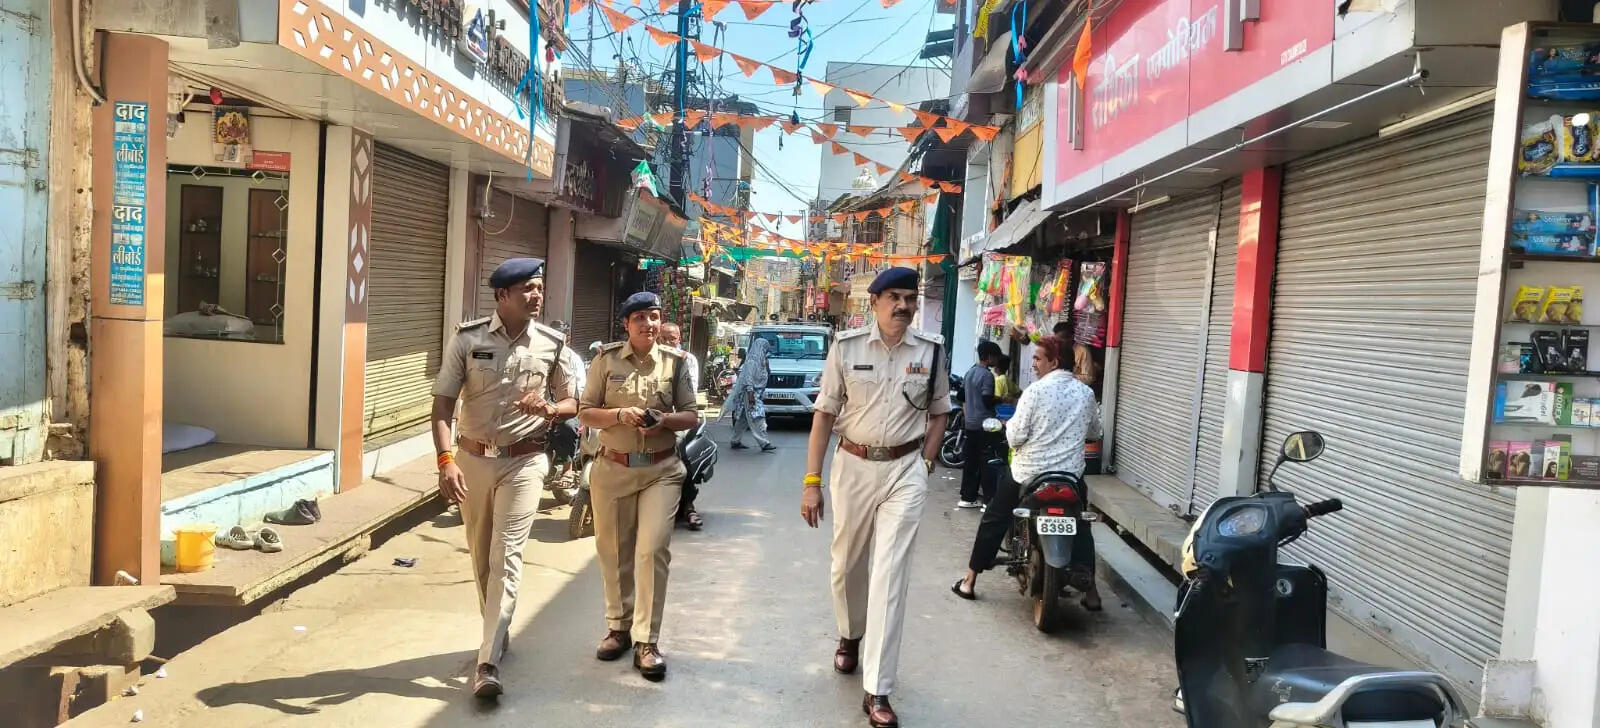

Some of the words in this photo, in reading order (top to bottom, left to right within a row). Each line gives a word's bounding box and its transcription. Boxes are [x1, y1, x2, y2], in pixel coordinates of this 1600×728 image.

[115, 103, 147, 122] दाद
[113, 206, 144, 224] दाद
[1041, 523, 1073, 533] 8398
